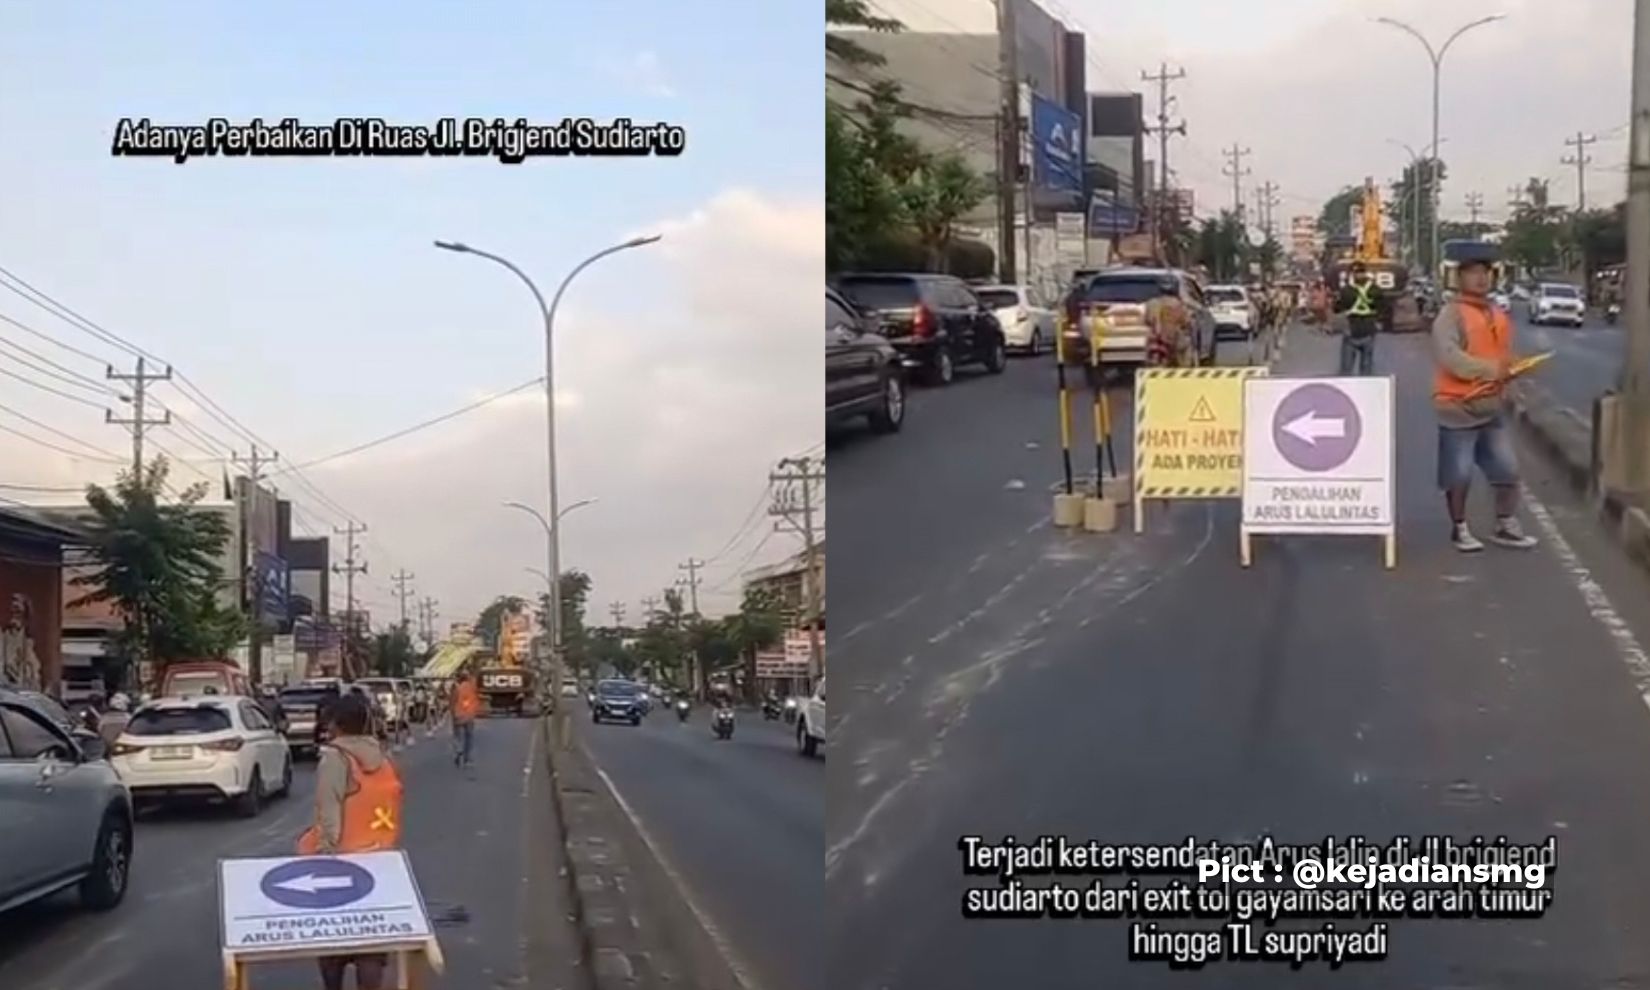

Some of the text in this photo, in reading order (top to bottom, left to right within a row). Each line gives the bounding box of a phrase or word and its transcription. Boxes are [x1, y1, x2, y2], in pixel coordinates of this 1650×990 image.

[1145, 428, 1188, 449] HATI
[1151, 453, 1184, 470] ADA
[1271, 485, 1362, 501] PENGALIHAN
[1253, 504, 1380, 519] ARUS LALULINTAS
[265, 913, 386, 931] PENGALIHAN
[241, 922, 414, 944] ARUS LALULINTAS
